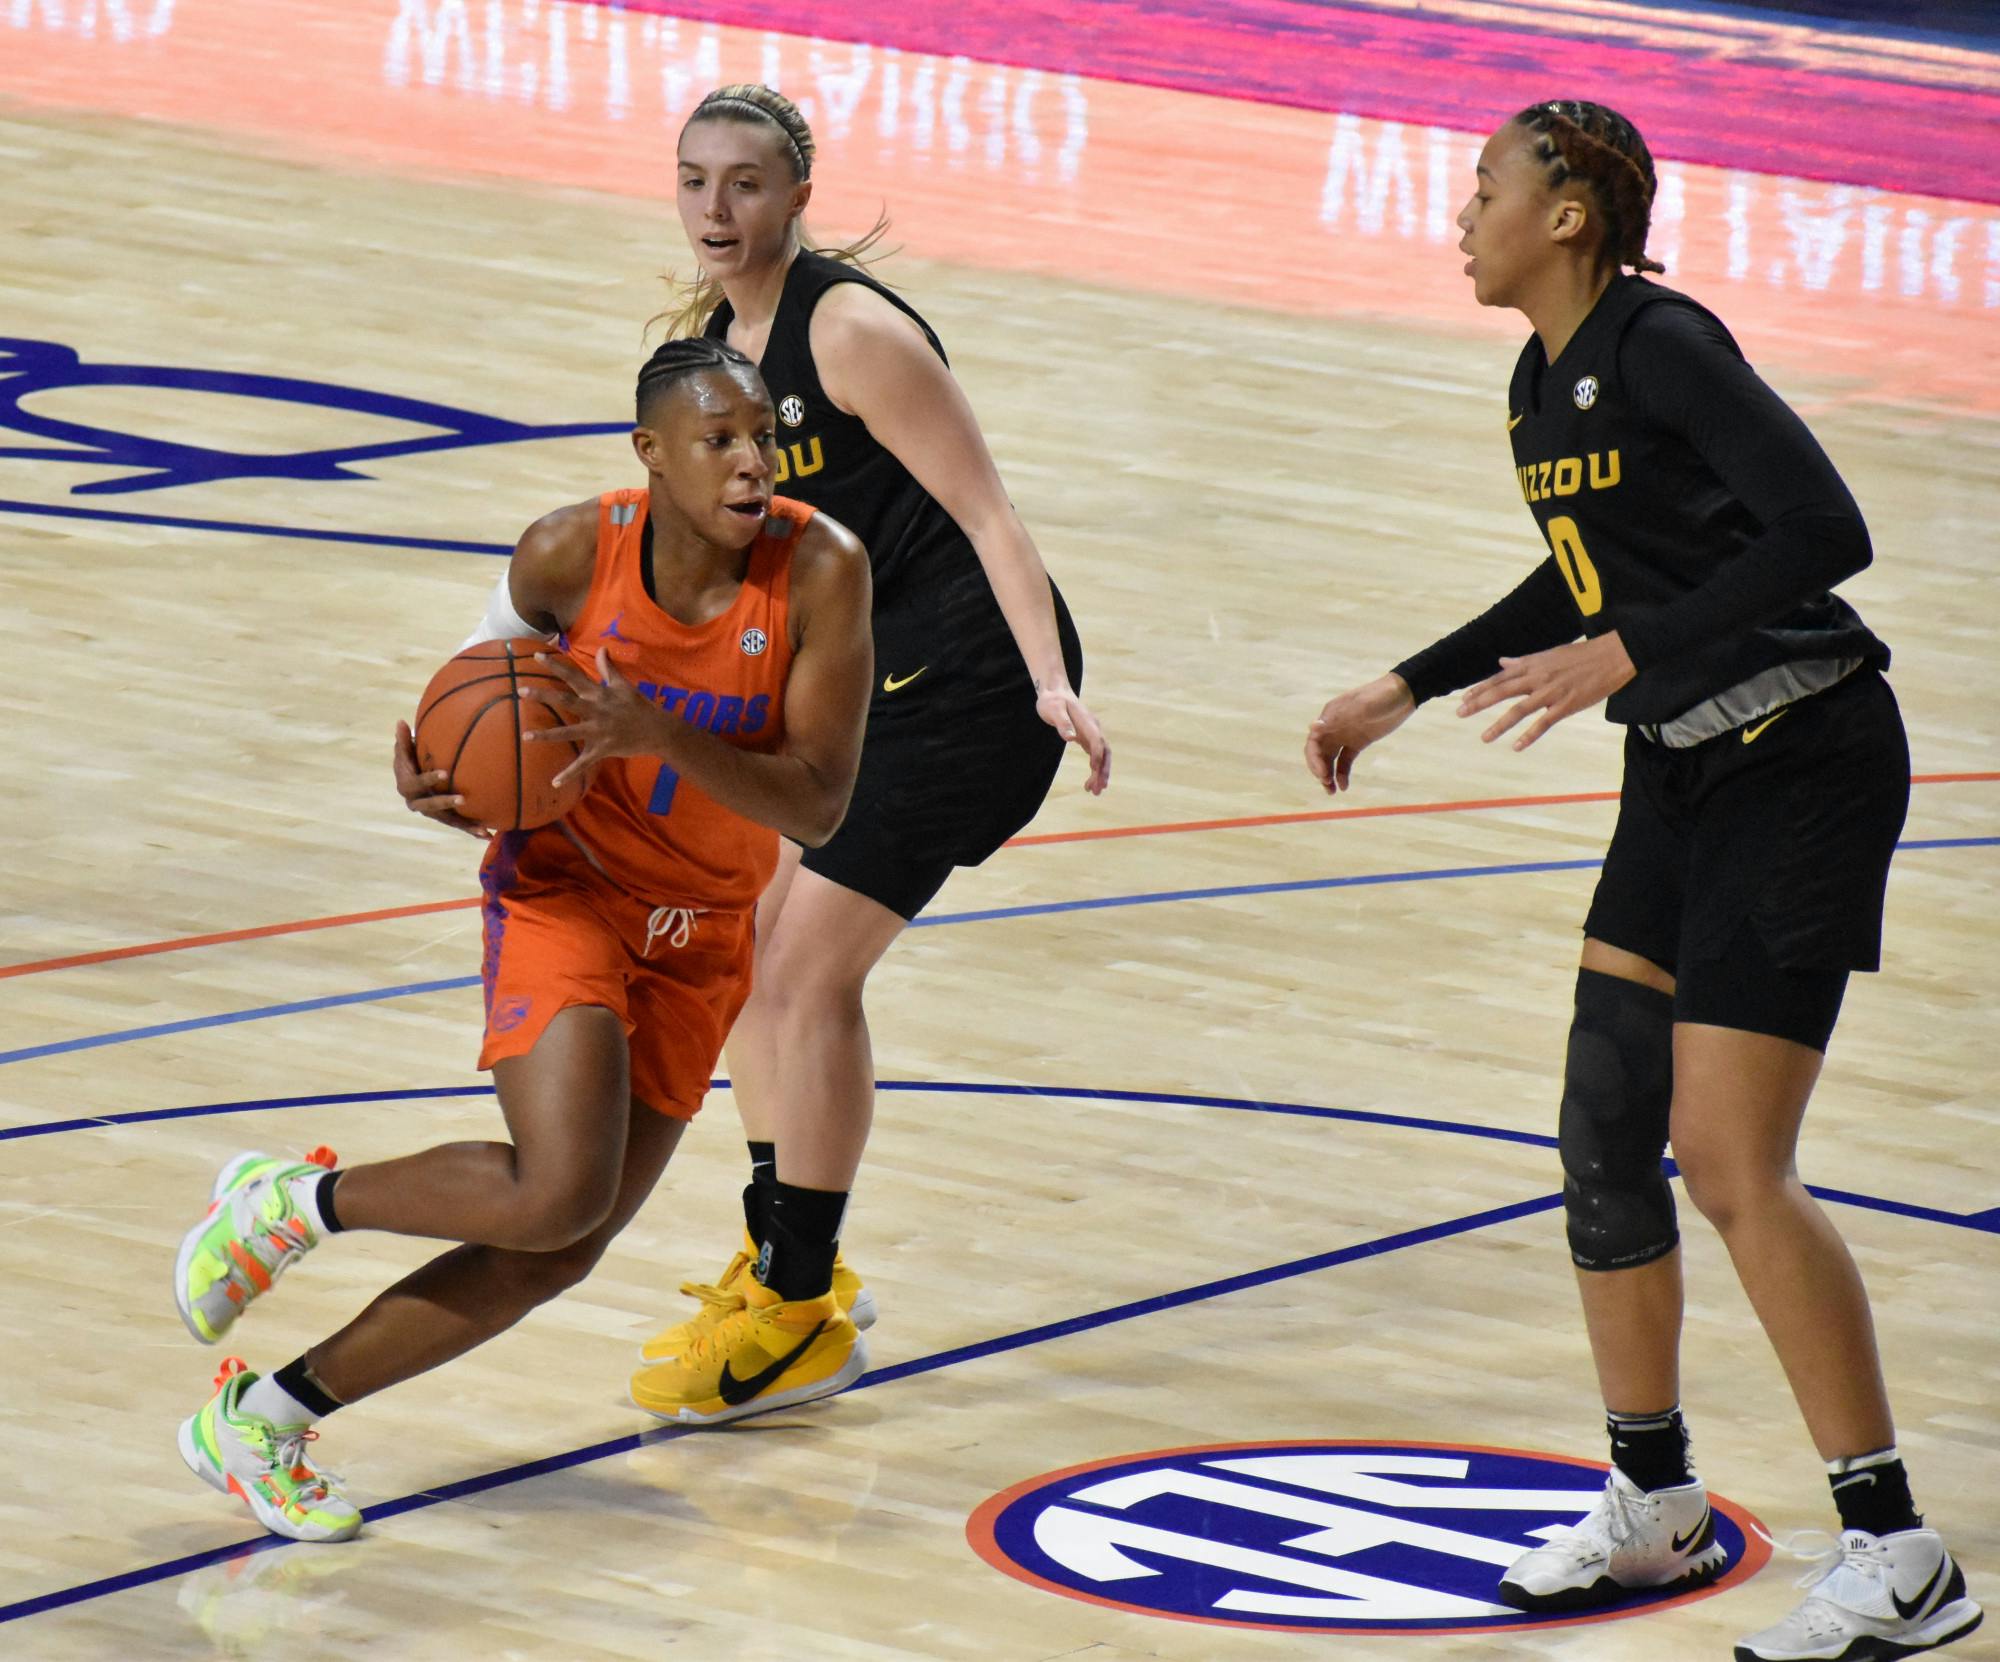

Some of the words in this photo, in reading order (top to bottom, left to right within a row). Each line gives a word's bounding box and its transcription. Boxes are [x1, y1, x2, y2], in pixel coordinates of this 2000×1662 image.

[1575, 377, 1598, 408] SEC
[780, 396, 803, 425] SEC
[1547, 515, 1602, 617] 0
[742, 629, 766, 654] SEC
[638, 679, 770, 735] TORS
